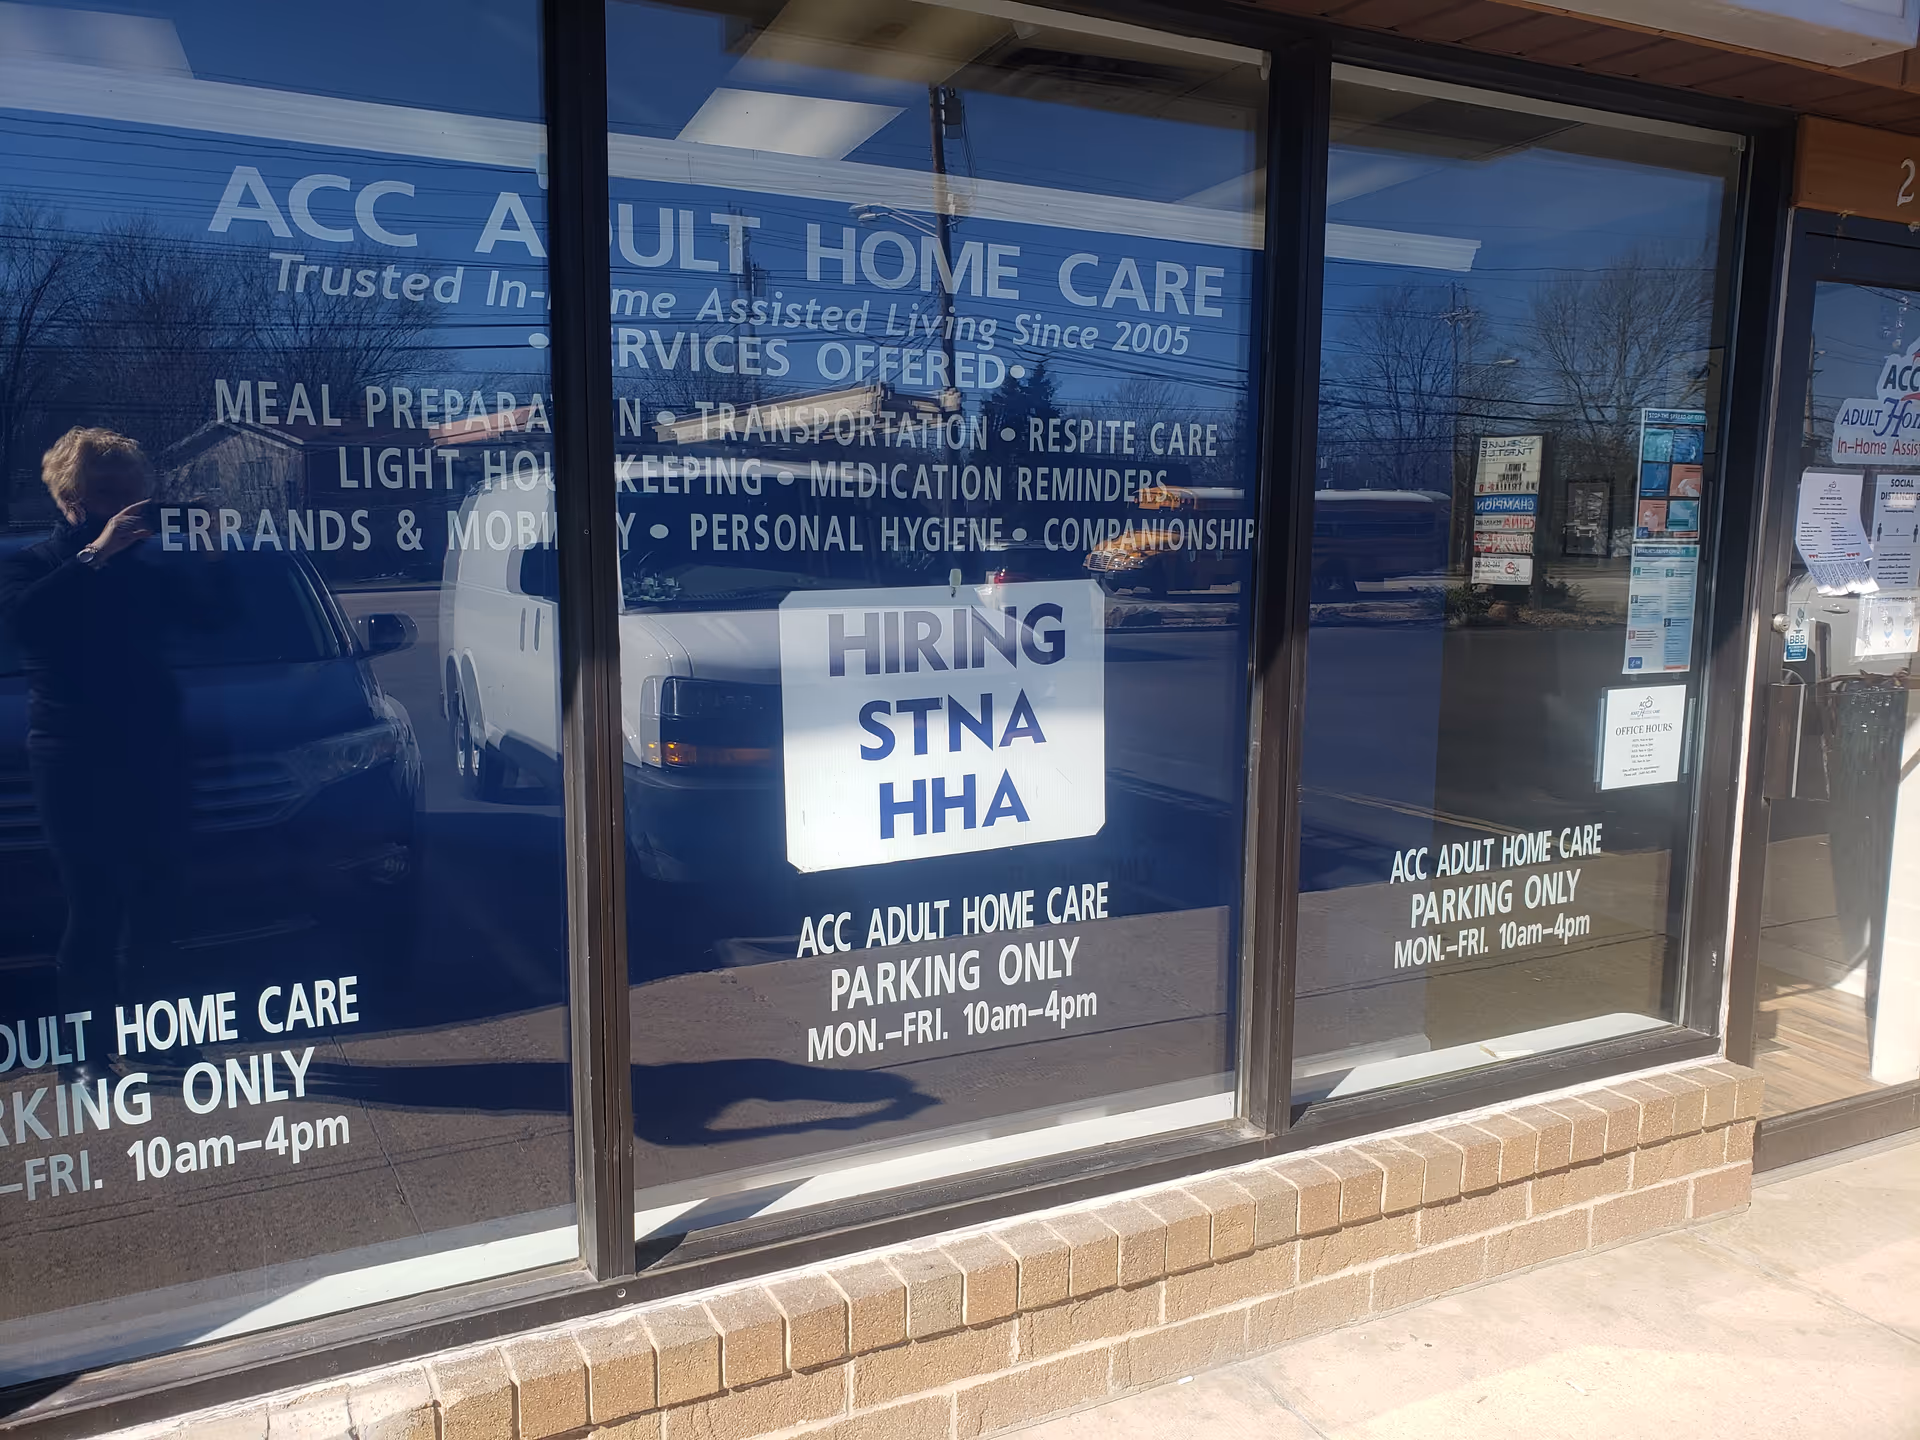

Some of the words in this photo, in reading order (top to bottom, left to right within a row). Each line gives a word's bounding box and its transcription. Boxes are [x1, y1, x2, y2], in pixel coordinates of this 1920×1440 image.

[1896, 157, 1916, 207] 2
[208, 166, 418, 248] ACC
[474, 191, 761, 275] AULT
[806, 224, 1021, 300] HOME
[1057, 253, 1225, 318] CARE
[269, 251, 464, 304] Trusted
[486, 270, 676, 319] In-me
[696, 288, 871, 335] Assisted
[885, 302, 1000, 351] Living
[1012, 313, 1099, 350] Since
[1111, 321, 1190, 357] 2005
[611, 327, 791, 377] RVICES
[816, 341, 1005, 389] OFFERED
[1883, 364, 1920, 392] ACC
[215, 378, 341, 428] MEAL
[365, 385, 642, 438] PREPARAN
[694, 400, 988, 452] TRANSPORTATION
[1028, 417, 1135, 455] RESPITE
[1150, 420, 1219, 458] CARE
[1837, 438, 1887, 455] In-Home
[1841, 409, 1883, 426] ADULT
[338, 447, 460, 490] LIGHT
[482, 448, 763, 498] HOUKEEPING
[810, 459, 1002, 502] MEDICATION
[1016, 467, 1169, 504] REMINDERS
[1891, 479, 1914, 487] SOCIAL
[160, 507, 372, 553] ERRANDS
[397, 509, 424, 552] &
[447, 509, 637, 552] MOBIY
[689, 513, 863, 553] PERSONAL
[881, 515, 1004, 553] HYGIENE
[1043, 516, 1256, 553] COMPANIONSHIP
[828, 602, 1066, 677] HIRING
[860, 688, 1046, 762] STNA
[1616, 725, 1643, 736] OFFICE
[1646, 723, 1673, 733] HOURS
[879, 768, 1031, 840] HHA
[1390, 847, 1428, 884] ACC
[1436, 838, 1494, 878] ADULT
[1502, 830, 1552, 868] HOME
[1560, 823, 1602, 859] CARE
[797, 911, 851, 958] ACC
[866, 900, 949, 949] ADULT
[962, 889, 1035, 936] HOME
[1046, 882, 1110, 925] CARE
[1410, 880, 1512, 928] PARKING
[1524, 868, 1582, 910] ONLY
[1394, 926, 1489, 969] MON.-FRI.
[1499, 912, 1590, 950] 10am-4pm
[830, 949, 981, 1011] PARKING
[998, 936, 1080, 986] ONLY
[116, 992, 238, 1056] HOME
[258, 976, 359, 1034] CARE
[808, 1007, 949, 1063] MON.-FRI.
[963, 990, 1098, 1036] 10am-4pm
[0, 1072, 152, 1148] KING
[182, 1047, 315, 1114] ONLY
[126, 1114, 350, 1182] 10am-4pm
